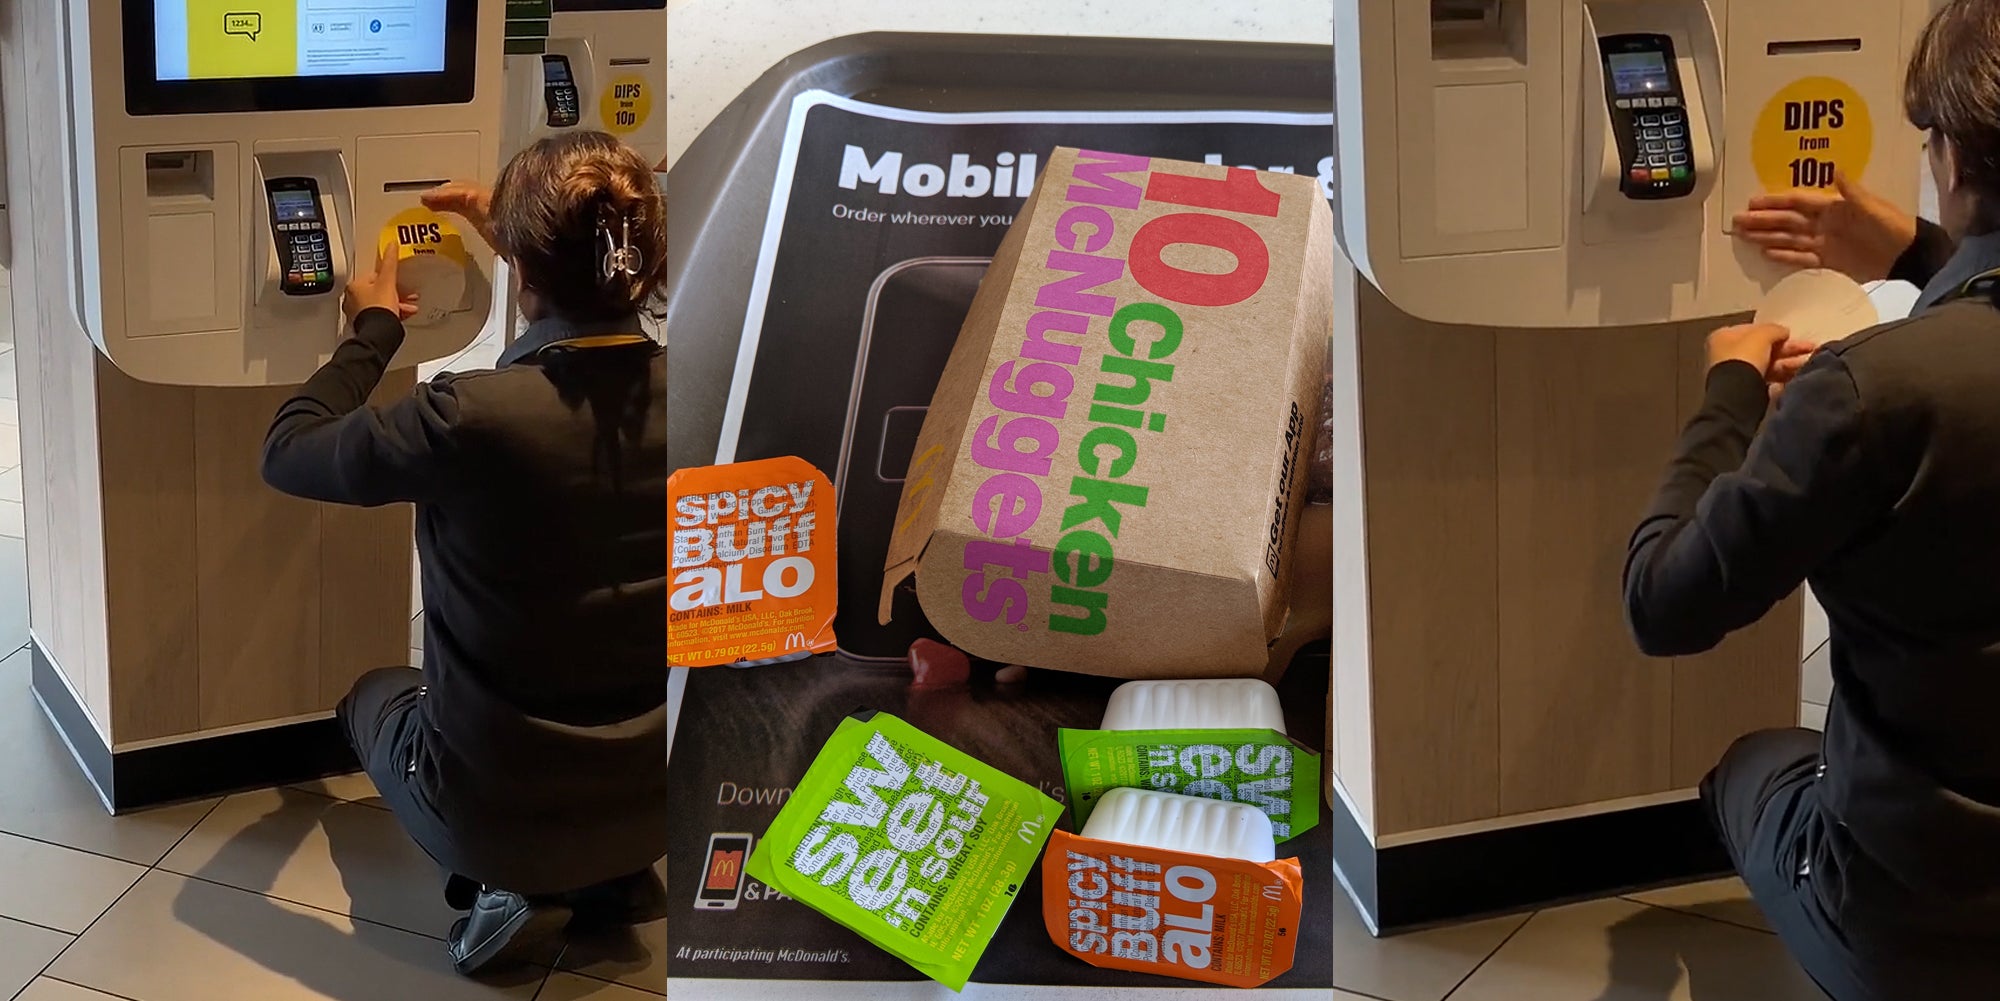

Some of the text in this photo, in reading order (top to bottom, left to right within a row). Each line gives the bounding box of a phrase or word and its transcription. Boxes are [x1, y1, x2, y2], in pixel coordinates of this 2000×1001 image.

[614, 84, 641, 99] DIPS
[616, 111, 635, 126] 10p
[1784, 99, 1844, 131] DIPS
[1800, 135, 1829, 150] from
[838, 144, 1037, 198] Mobil
[1789, 158, 1836, 188] 10p
[397, 223, 441, 245] DIPS
[832, 203, 1013, 228] Order wherever you
[1127, 166, 1281, 307] 10
[1048, 302, 1184, 636] Chicken
[1270, 401, 1298, 545] Get our App
[792, 537, 814, 549] EDTA
[669, 601, 751, 622] CONTAINS: MILK
[667, 641, 777, 664] NET WT 0.79 OZ (22.5g)
[1136, 745, 1149, 777] CONTAINS:
[717, 781, 792, 805] Down
[784, 806, 831, 868] INGREDIENTS:
[826, 785, 847, 807] High
[839, 750, 869, 786] Fructose
[793, 734, 890, 873] Syrup, Water, Apricot Puree
[801, 738, 899, 878] Concentrate and/or Peach Puree
[810, 740, 910, 884] Concentrate, Distilled Vinegar,
[818, 849, 850, 888] Contains
[858, 820, 869, 831] or
[881, 775, 900, 794] Soy
[893, 747, 916, 774] Sauce
[836, 875, 856, 898] Salt,
[850, 837, 881, 876] Modified
[876, 816, 895, 839] Food
[845, 878, 866, 903] Wine
[886, 798, 919, 840] Dextrose,
[912, 761, 943, 798] Soybean
[854, 890, 871, 907] Oil,
[865, 854, 894, 891] Xanthan
[888, 829, 910, 855] Gum,
[903, 798, 931, 831] Spices,
[863, 870, 895, 912] Benzoate
[931, 768, 958, 801] Natural
[764, 887, 793, 901] PA
[898, 920, 910, 932] of
[905, 886, 934, 922] Paprika
[925, 852, 954, 888] (Color),
[944, 816, 975, 855] Succinic
[908, 816, 989, 939] CONTAINS: WHEAT, SOY
[950, 858, 1018, 962] NET WT 1 OZ (28.3g)
[1264, 904, 1280, 929] (22.5g)
[676, 946, 850, 963] At participating McDonald's.
[1211, 914, 1226, 971] CONTAINS: MILK
[1262, 938, 1274, 954] 0.79
